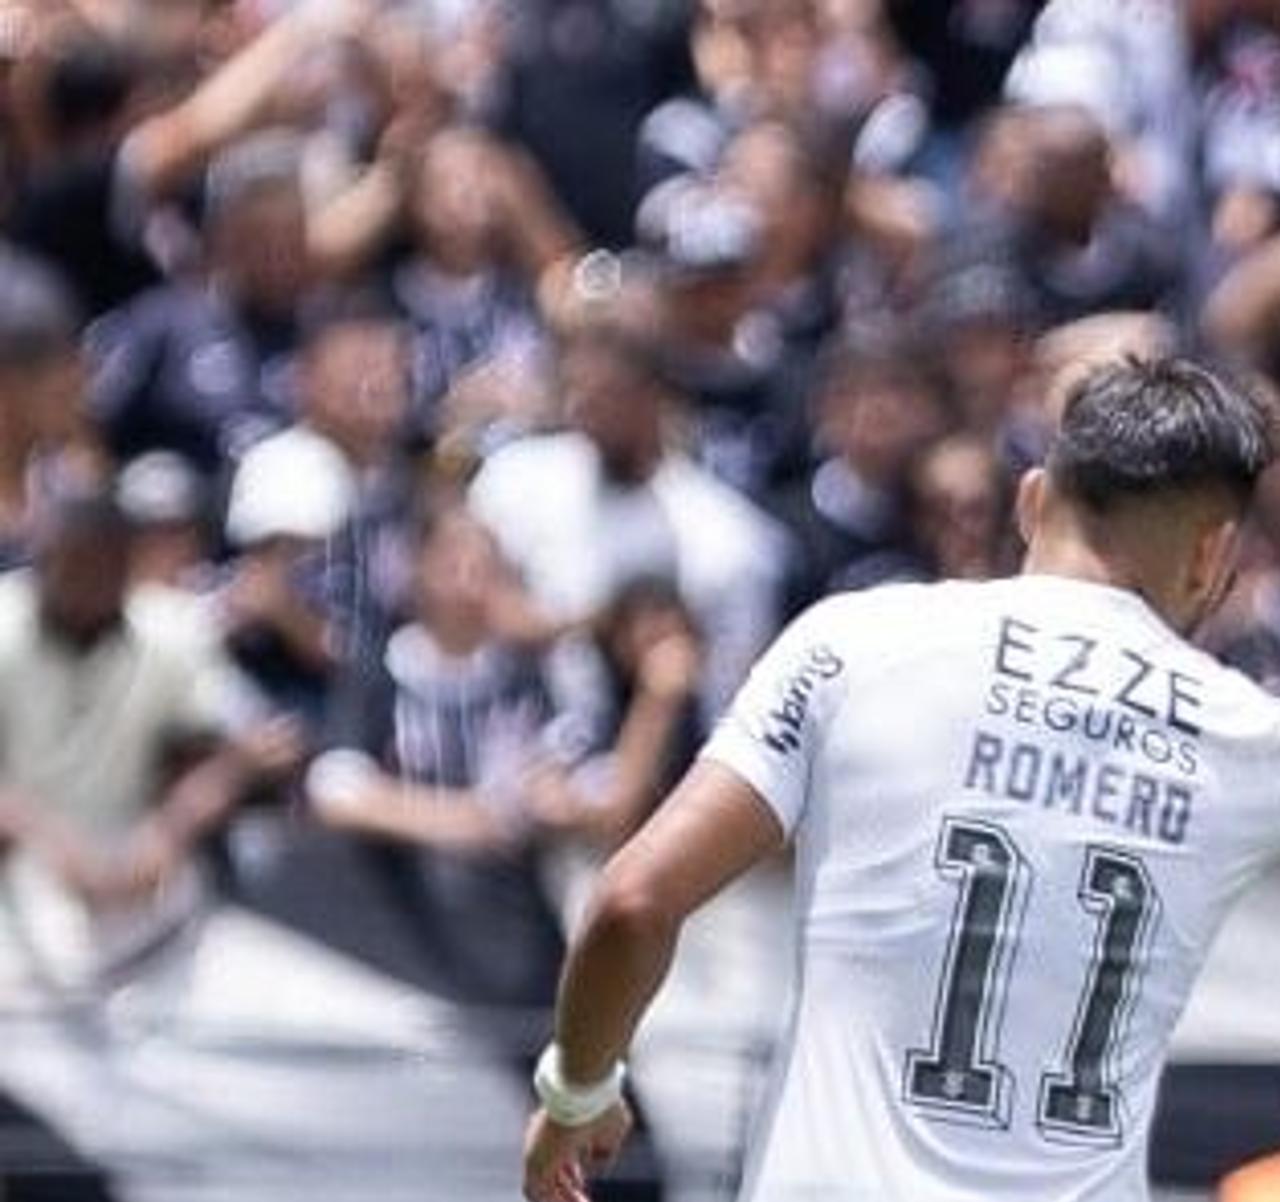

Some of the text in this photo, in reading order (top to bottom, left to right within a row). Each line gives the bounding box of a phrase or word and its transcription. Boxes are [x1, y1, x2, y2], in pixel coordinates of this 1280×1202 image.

[986, 681, 1198, 776] SEGUROS
[995, 616, 1204, 737] EZZE
[963, 731, 1194, 846] ROMERO
[902, 815, 1164, 1149] 11
